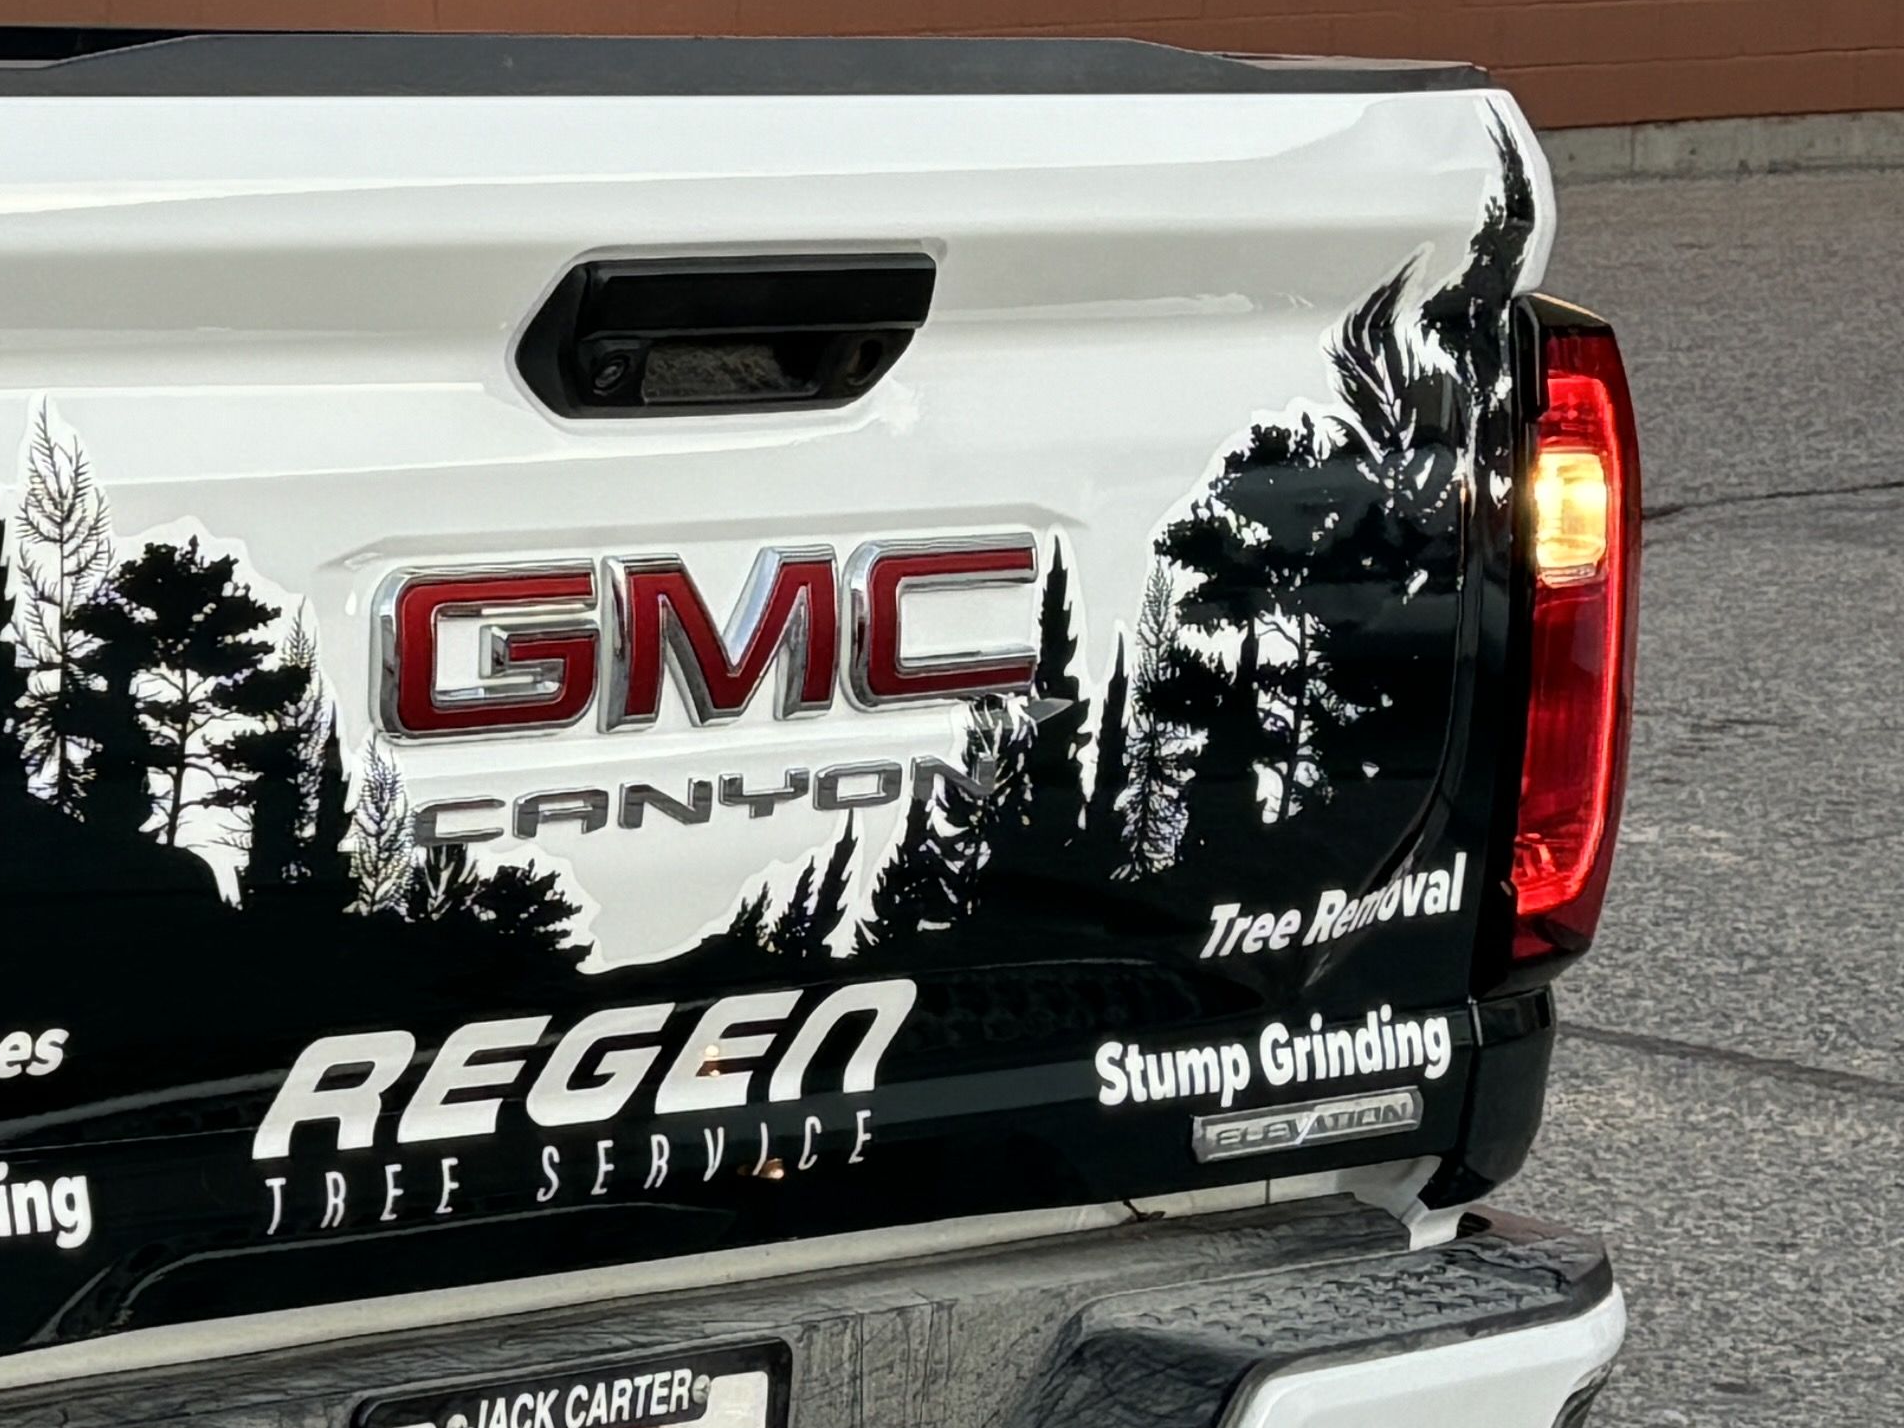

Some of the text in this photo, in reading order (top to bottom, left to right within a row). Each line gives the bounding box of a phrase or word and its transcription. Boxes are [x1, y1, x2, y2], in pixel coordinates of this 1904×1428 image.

[368, 532, 1038, 744] GMC
[414, 755, 996, 844] CANYON
[1199, 852, 1467, 959] Tree Removal
[252, 978, 917, 1161] REGEN
[1095, 1003, 1452, 1108] Stump Grinding
[265, 1109, 873, 1236] TREE SERVICE
[1217, 1101, 1409, 1146] ELEVATION
